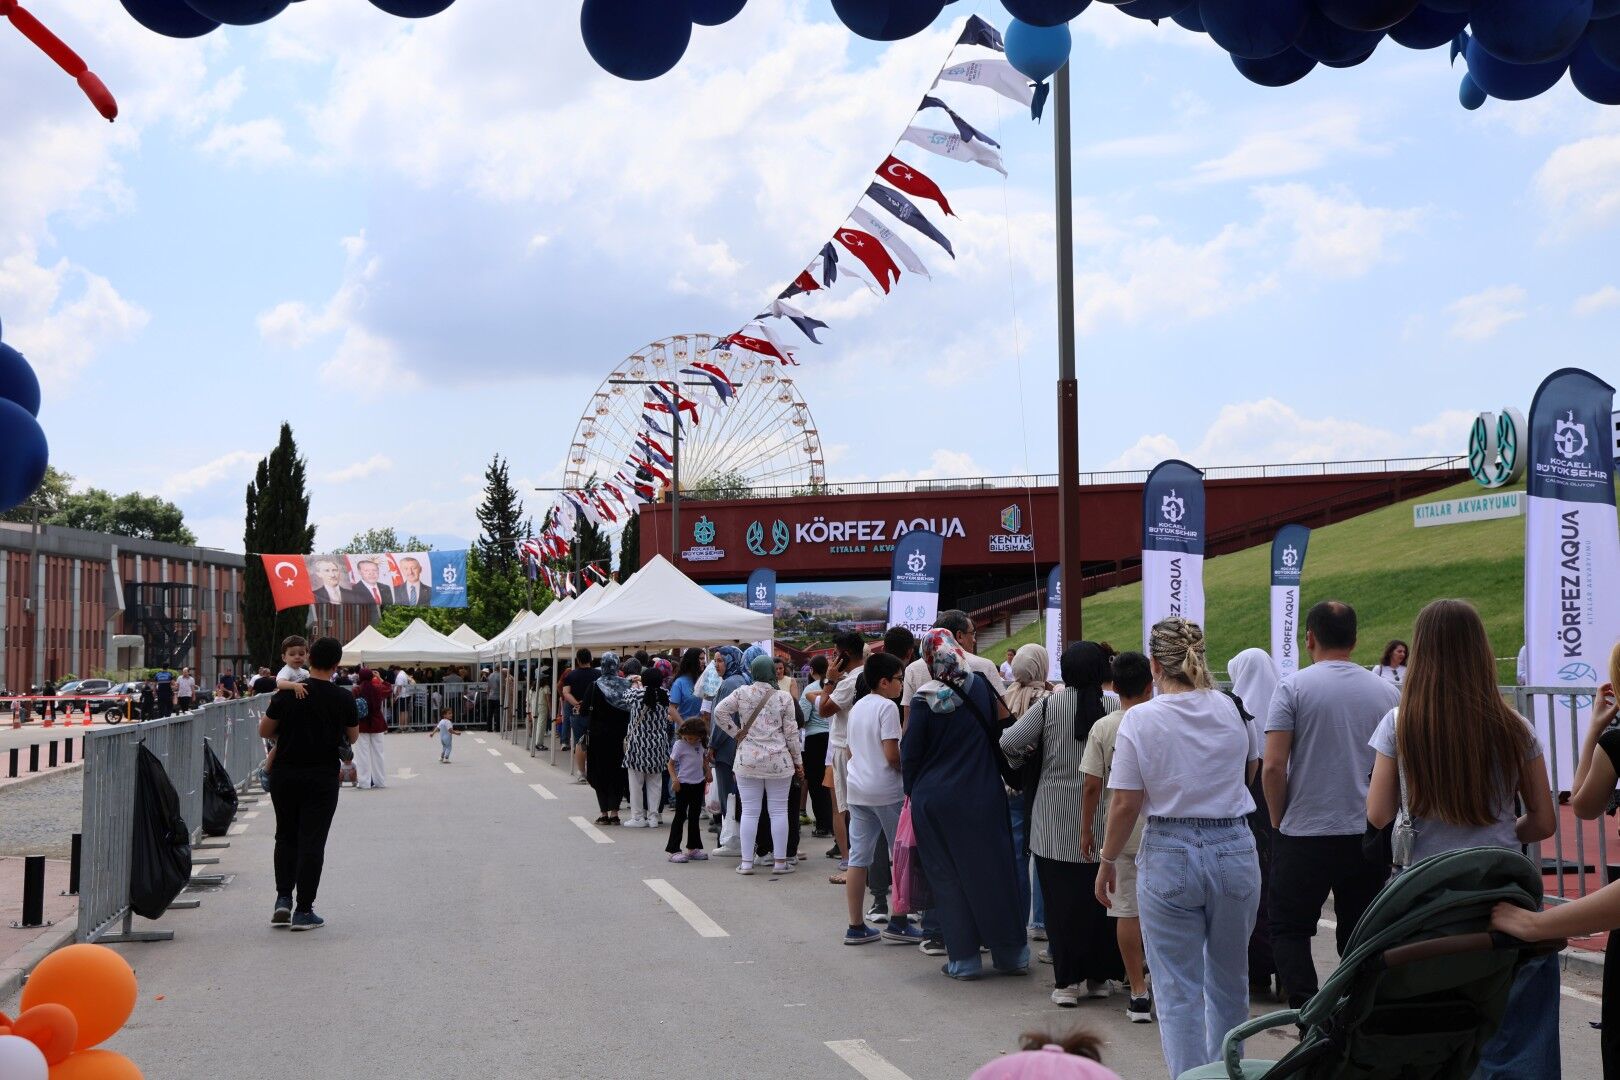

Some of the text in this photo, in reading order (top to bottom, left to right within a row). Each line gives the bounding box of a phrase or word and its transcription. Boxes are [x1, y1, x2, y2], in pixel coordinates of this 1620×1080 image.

[1536, 463, 1608, 479] BÜYÜKŞEHİR
[1550, 457, 1592, 469] KOCAELİ
[1415, 494, 1518, 519] KITALAR AKVARYUMU
[795, 516, 886, 543] KÖRFEZ
[990, 535, 1031, 544] KENTİM
[830, 545, 866, 554] KITALAR
[1170, 558, 1182, 602] AQUA
[1557, 510, 1582, 658] KÖRFEZ AQUA
[1284, 590, 1294, 619] AQUA
[1282, 620, 1293, 658] KÖRFEZ
